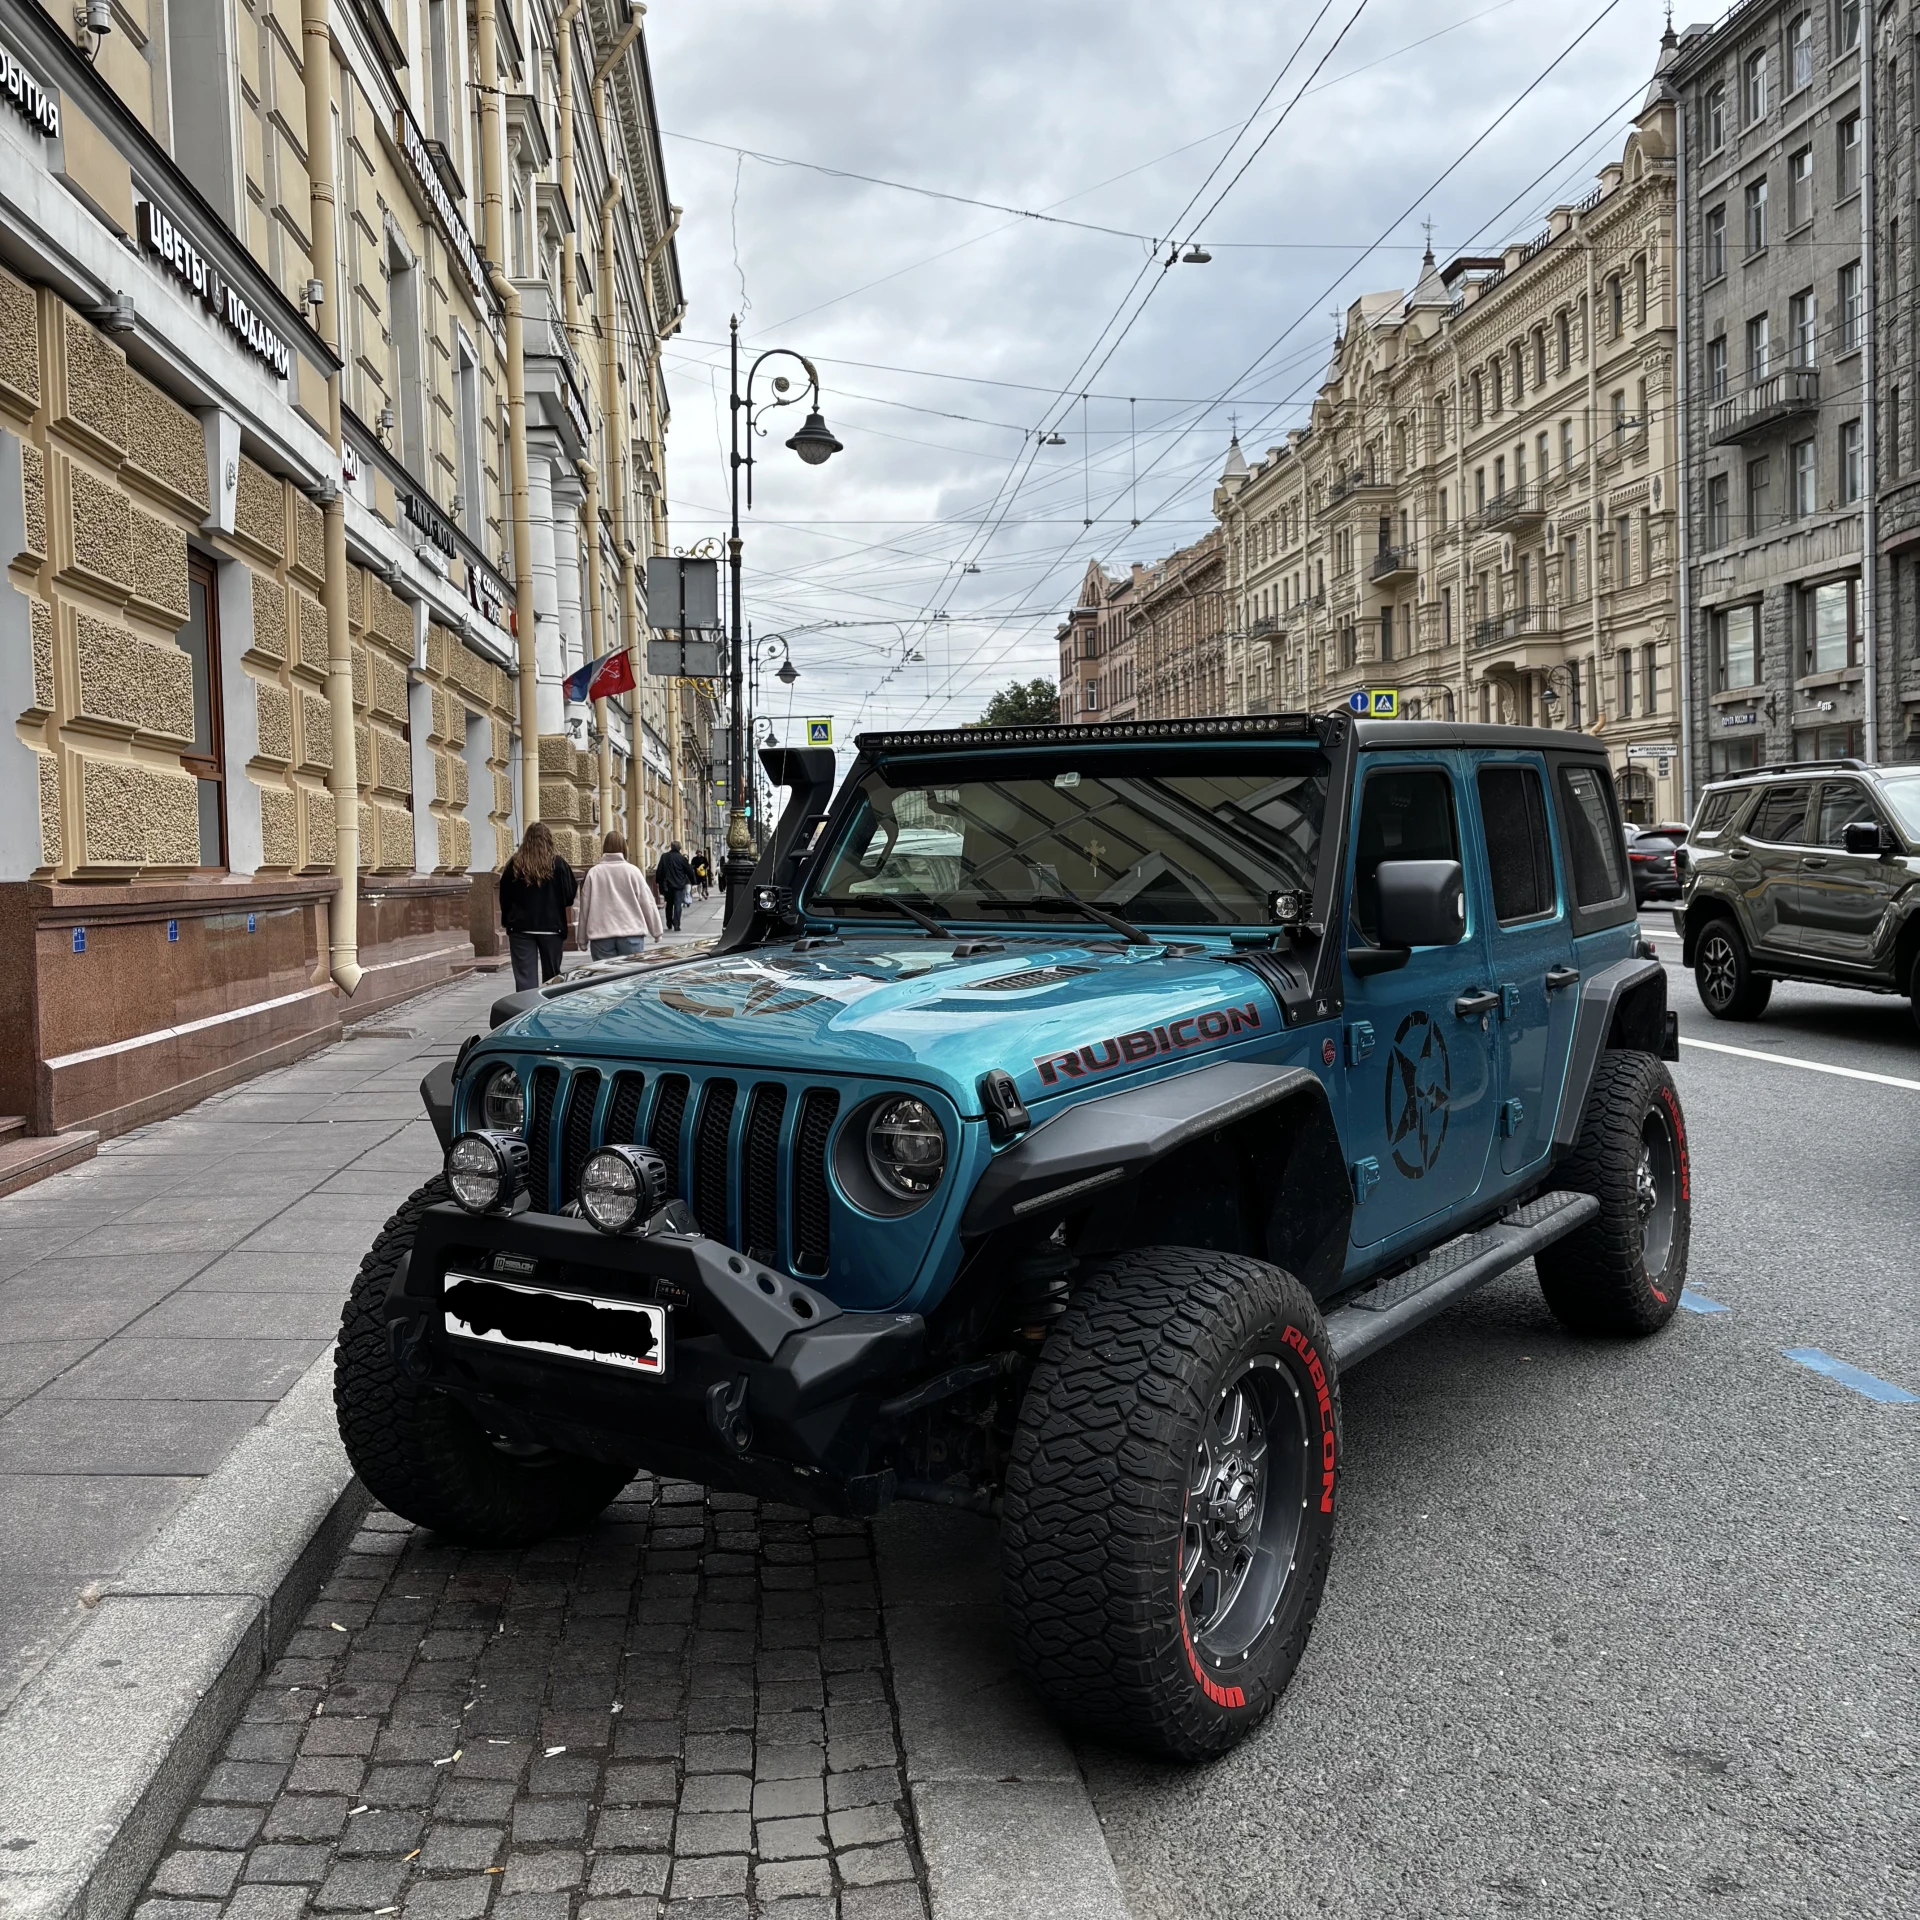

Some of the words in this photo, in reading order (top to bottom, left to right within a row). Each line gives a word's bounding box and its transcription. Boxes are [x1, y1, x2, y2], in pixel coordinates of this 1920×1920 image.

[150, 202, 207, 297] ЦВЕТЫ
[227, 286, 290, 380] ПОДАРКИ
[1032, 1002, 1261, 1086] RUBICON
[1661, 1086, 1689, 1200] RUBICON
[1280, 1324, 1335, 1513] RUBICON
